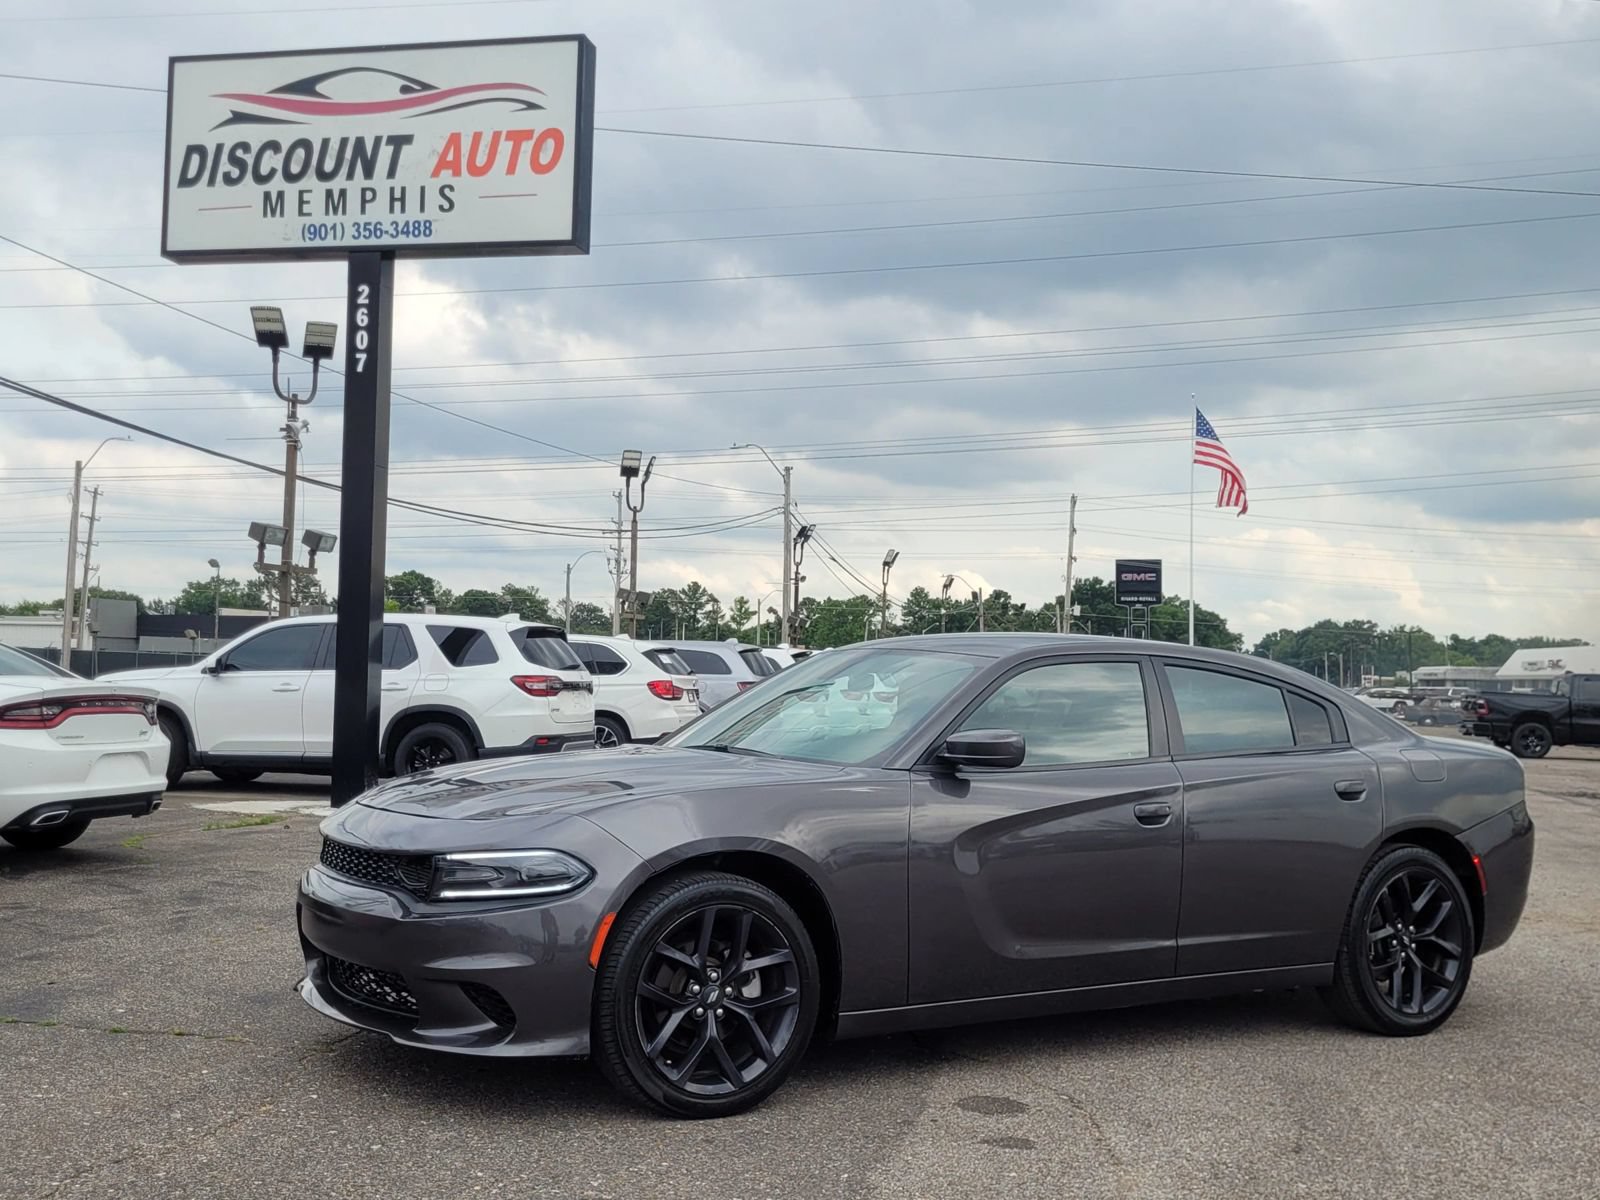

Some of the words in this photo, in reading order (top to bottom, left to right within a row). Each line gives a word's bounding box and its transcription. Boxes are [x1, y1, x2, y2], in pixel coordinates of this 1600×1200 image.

[177, 134, 414, 189] DISCOUNT
[430, 127, 565, 179] AUTO
[262, 184, 456, 218] MEMPHIS
[301, 222, 345, 242] (901)
[351, 219, 433, 240] 356-3488
[355, 284, 370, 373] 2607
[1121, 573, 1157, 581] GMC
